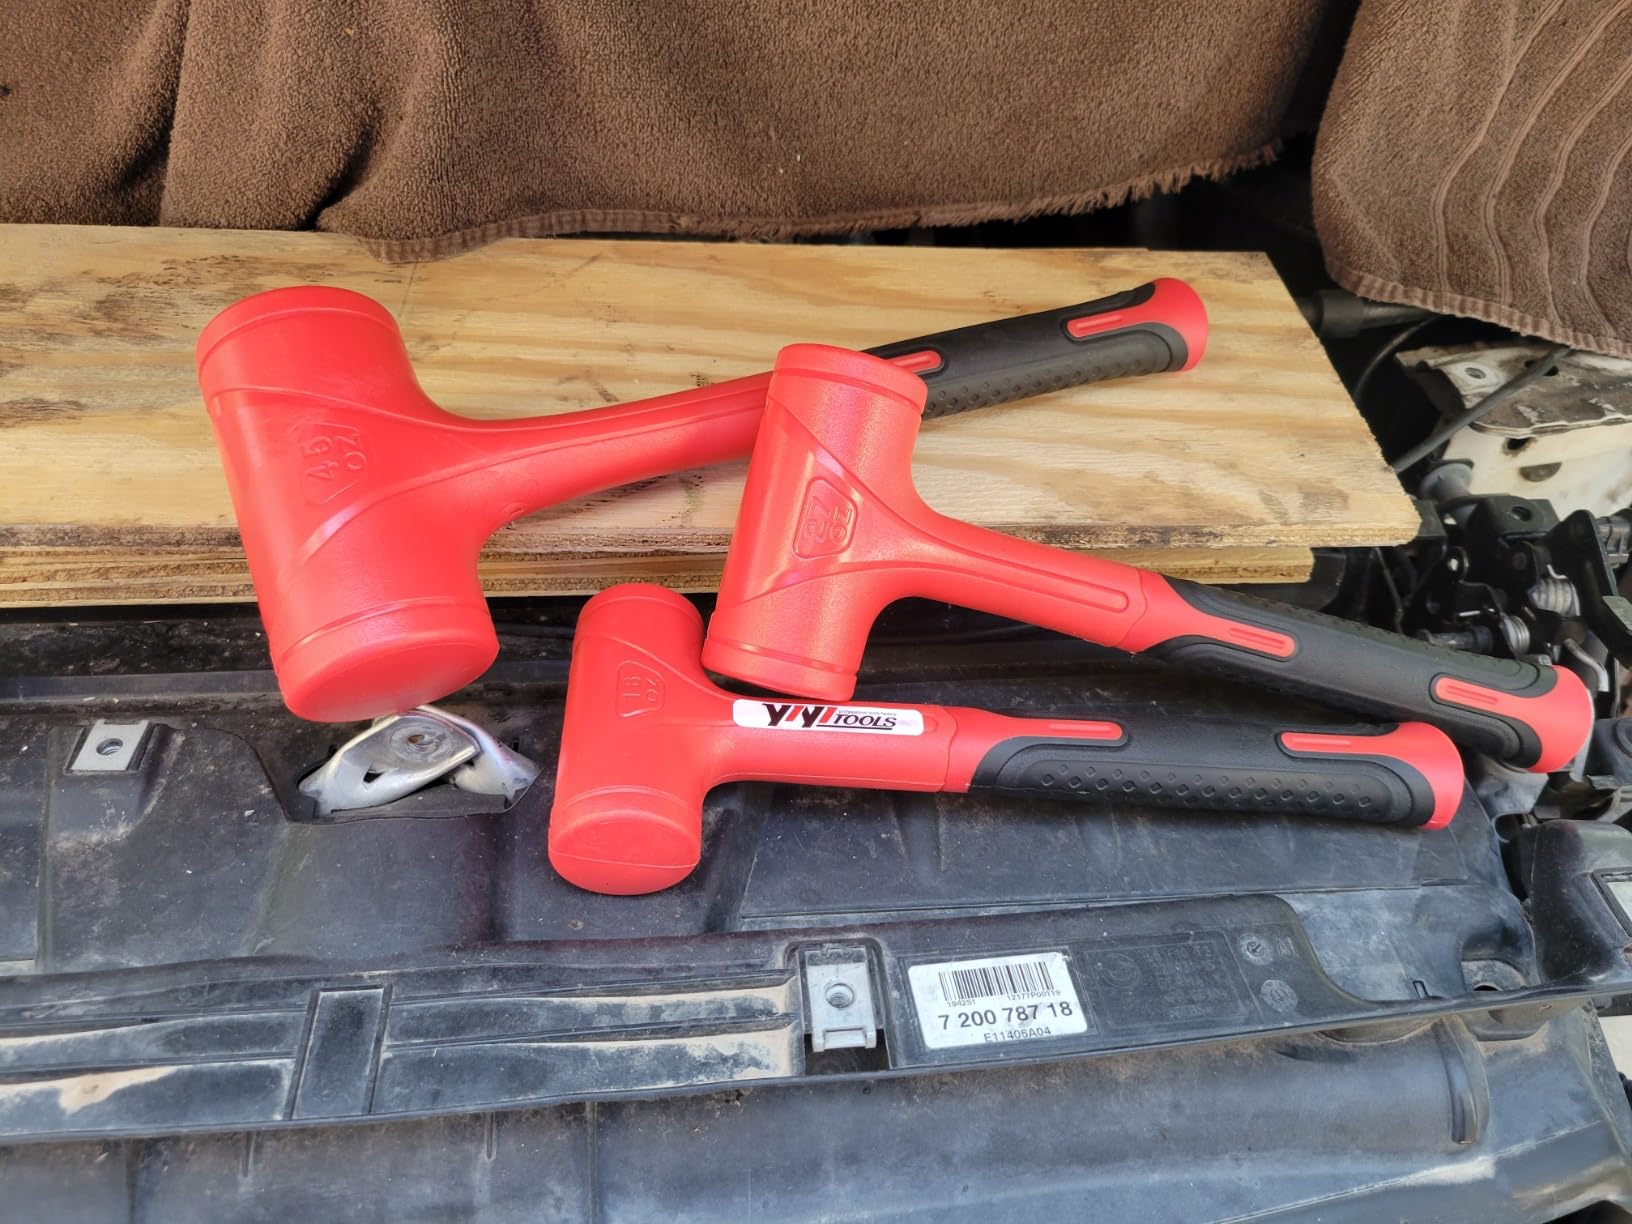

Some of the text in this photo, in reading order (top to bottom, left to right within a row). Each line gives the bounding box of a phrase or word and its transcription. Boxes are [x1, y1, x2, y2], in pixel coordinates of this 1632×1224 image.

[302, 435, 338, 481] 45
[762, 703, 897, 728] YIYI TOOLS
[938, 1001, 1073, 1030] 7 200 787 18
[947, 999, 976, 1008] 194251
[984, 1026, 1052, 1043] E11405A04
